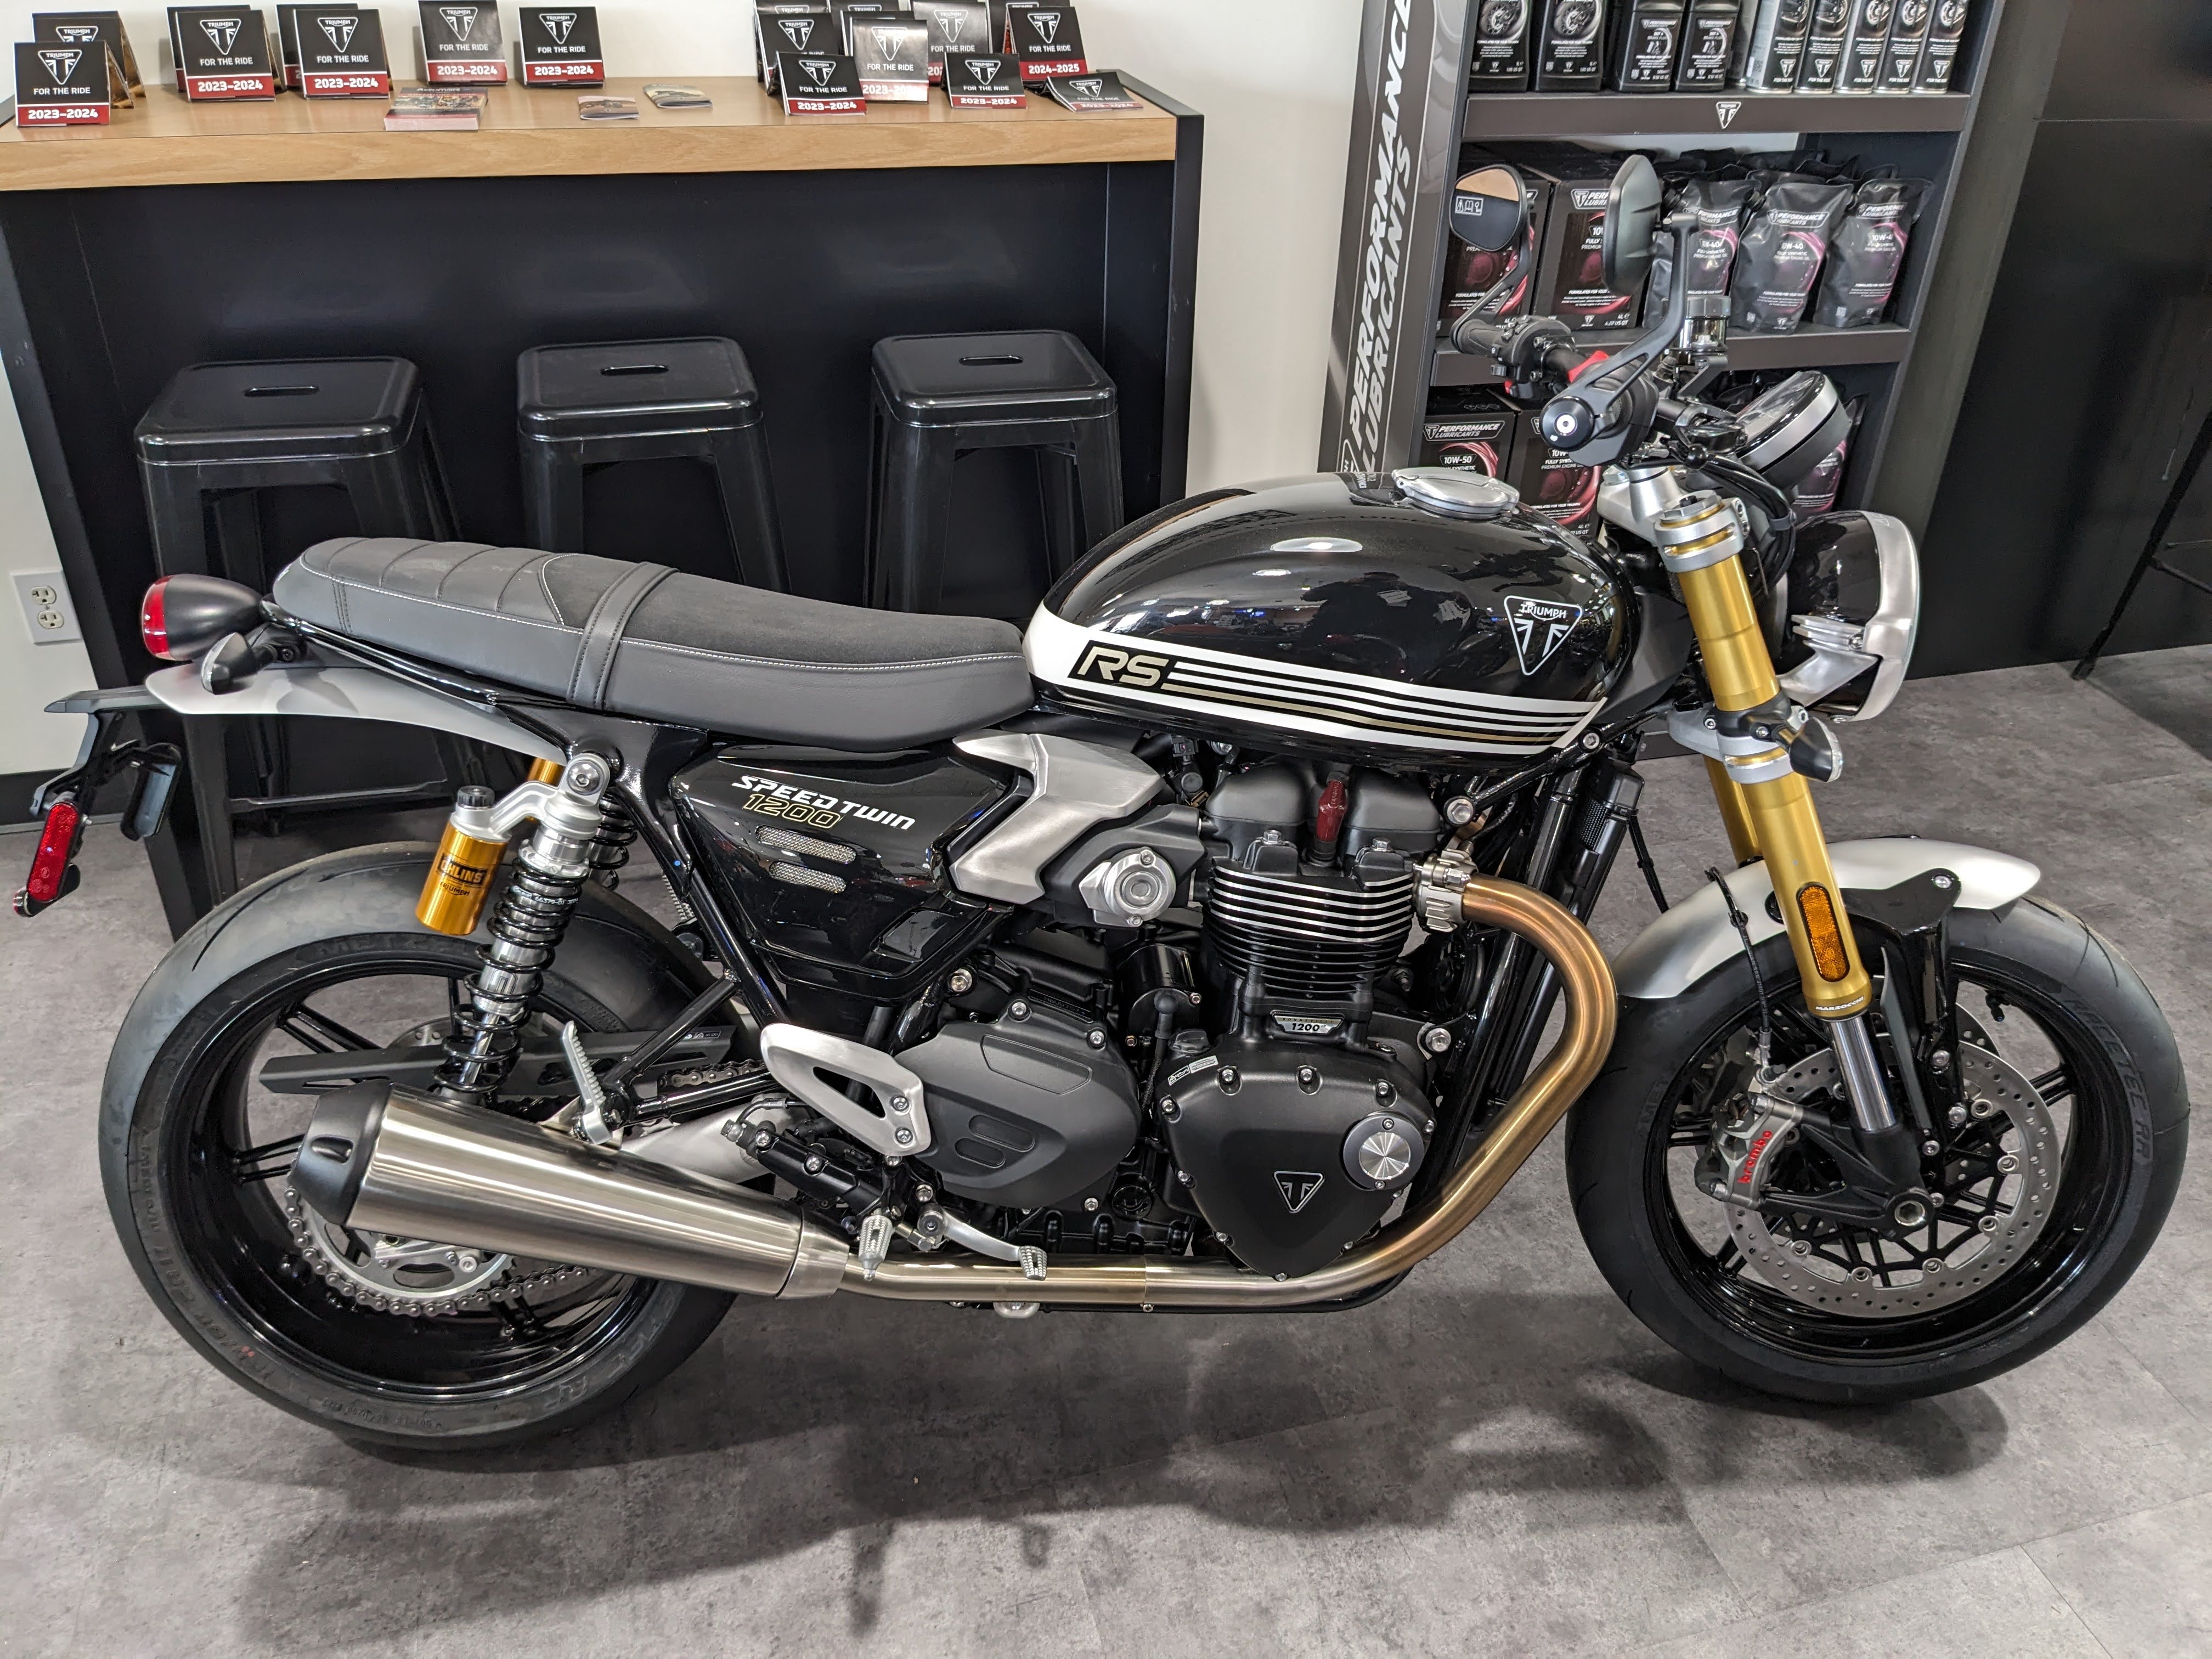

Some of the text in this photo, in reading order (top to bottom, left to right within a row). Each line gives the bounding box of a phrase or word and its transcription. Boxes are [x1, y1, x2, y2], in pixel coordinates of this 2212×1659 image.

[200, 57, 253, 66] FOR THE RIDE
[317, 55, 369, 64] FOR THE RIDE
[438, 65, 497, 76] 2023-2024
[534, 65, 594, 76] 2023-2024
[1029, 64, 1080, 74] 2024-2025
[198, 77, 263, 92] 2023-2024
[314, 77, 379, 89] 2023-2024
[798, 102, 857, 111] 2023-2024
[28, 109, 98, 120] 2023-2024
[1362, 135, 1410, 472] LUBRICANTS
[1438, 424, 1500, 432] PERFORMANCE
[1444, 455, 1472, 464] 10W-50
[1520, 603, 1567, 619] TRIUMPH
[1077, 646, 1169, 686] RS
[731, 775, 916, 830] SPEED TWIN
[742, 793, 843, 829] 1200
[1815, 996, 1864, 1011] MARZOCCHI
[1292, 1023, 1320, 1031] 1200
[1737, 1130, 1773, 1184] brembo
